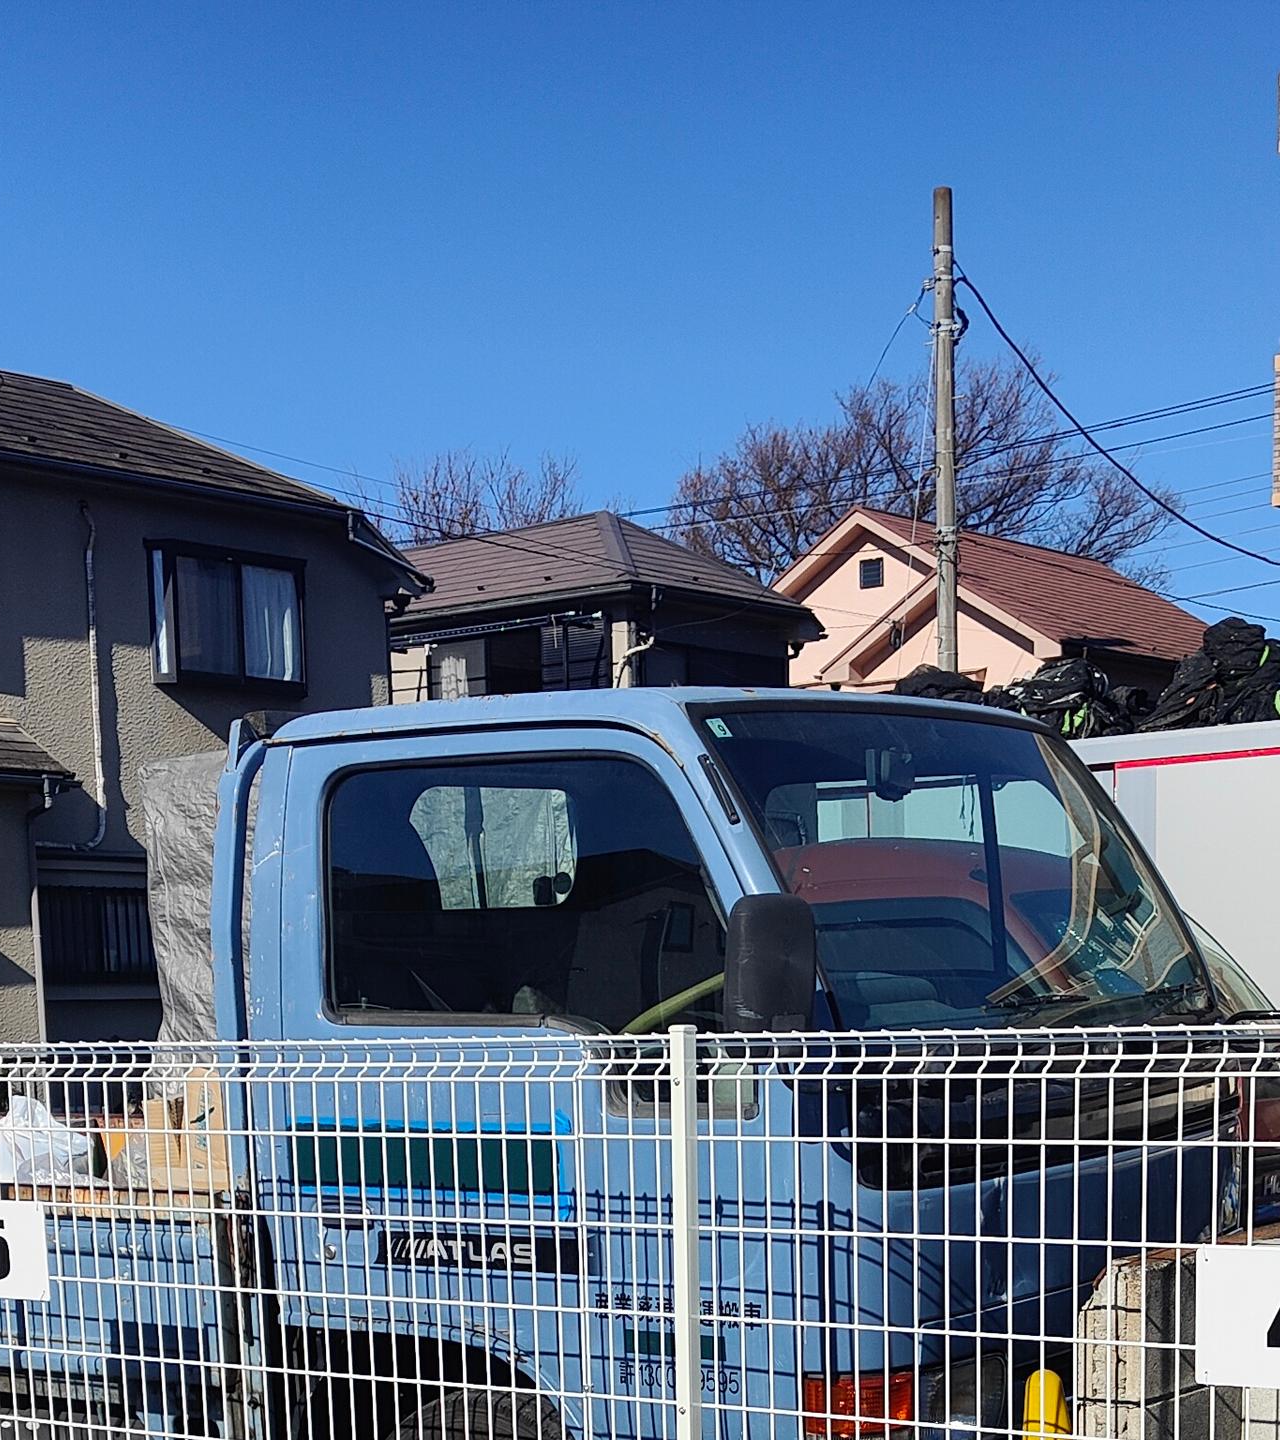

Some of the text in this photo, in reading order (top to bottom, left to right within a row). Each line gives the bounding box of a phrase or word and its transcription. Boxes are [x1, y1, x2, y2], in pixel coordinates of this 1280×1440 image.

[425, 1238, 537, 1265] ATLAS
[594, 1292, 763, 1331] 産業廃棄運搬車
